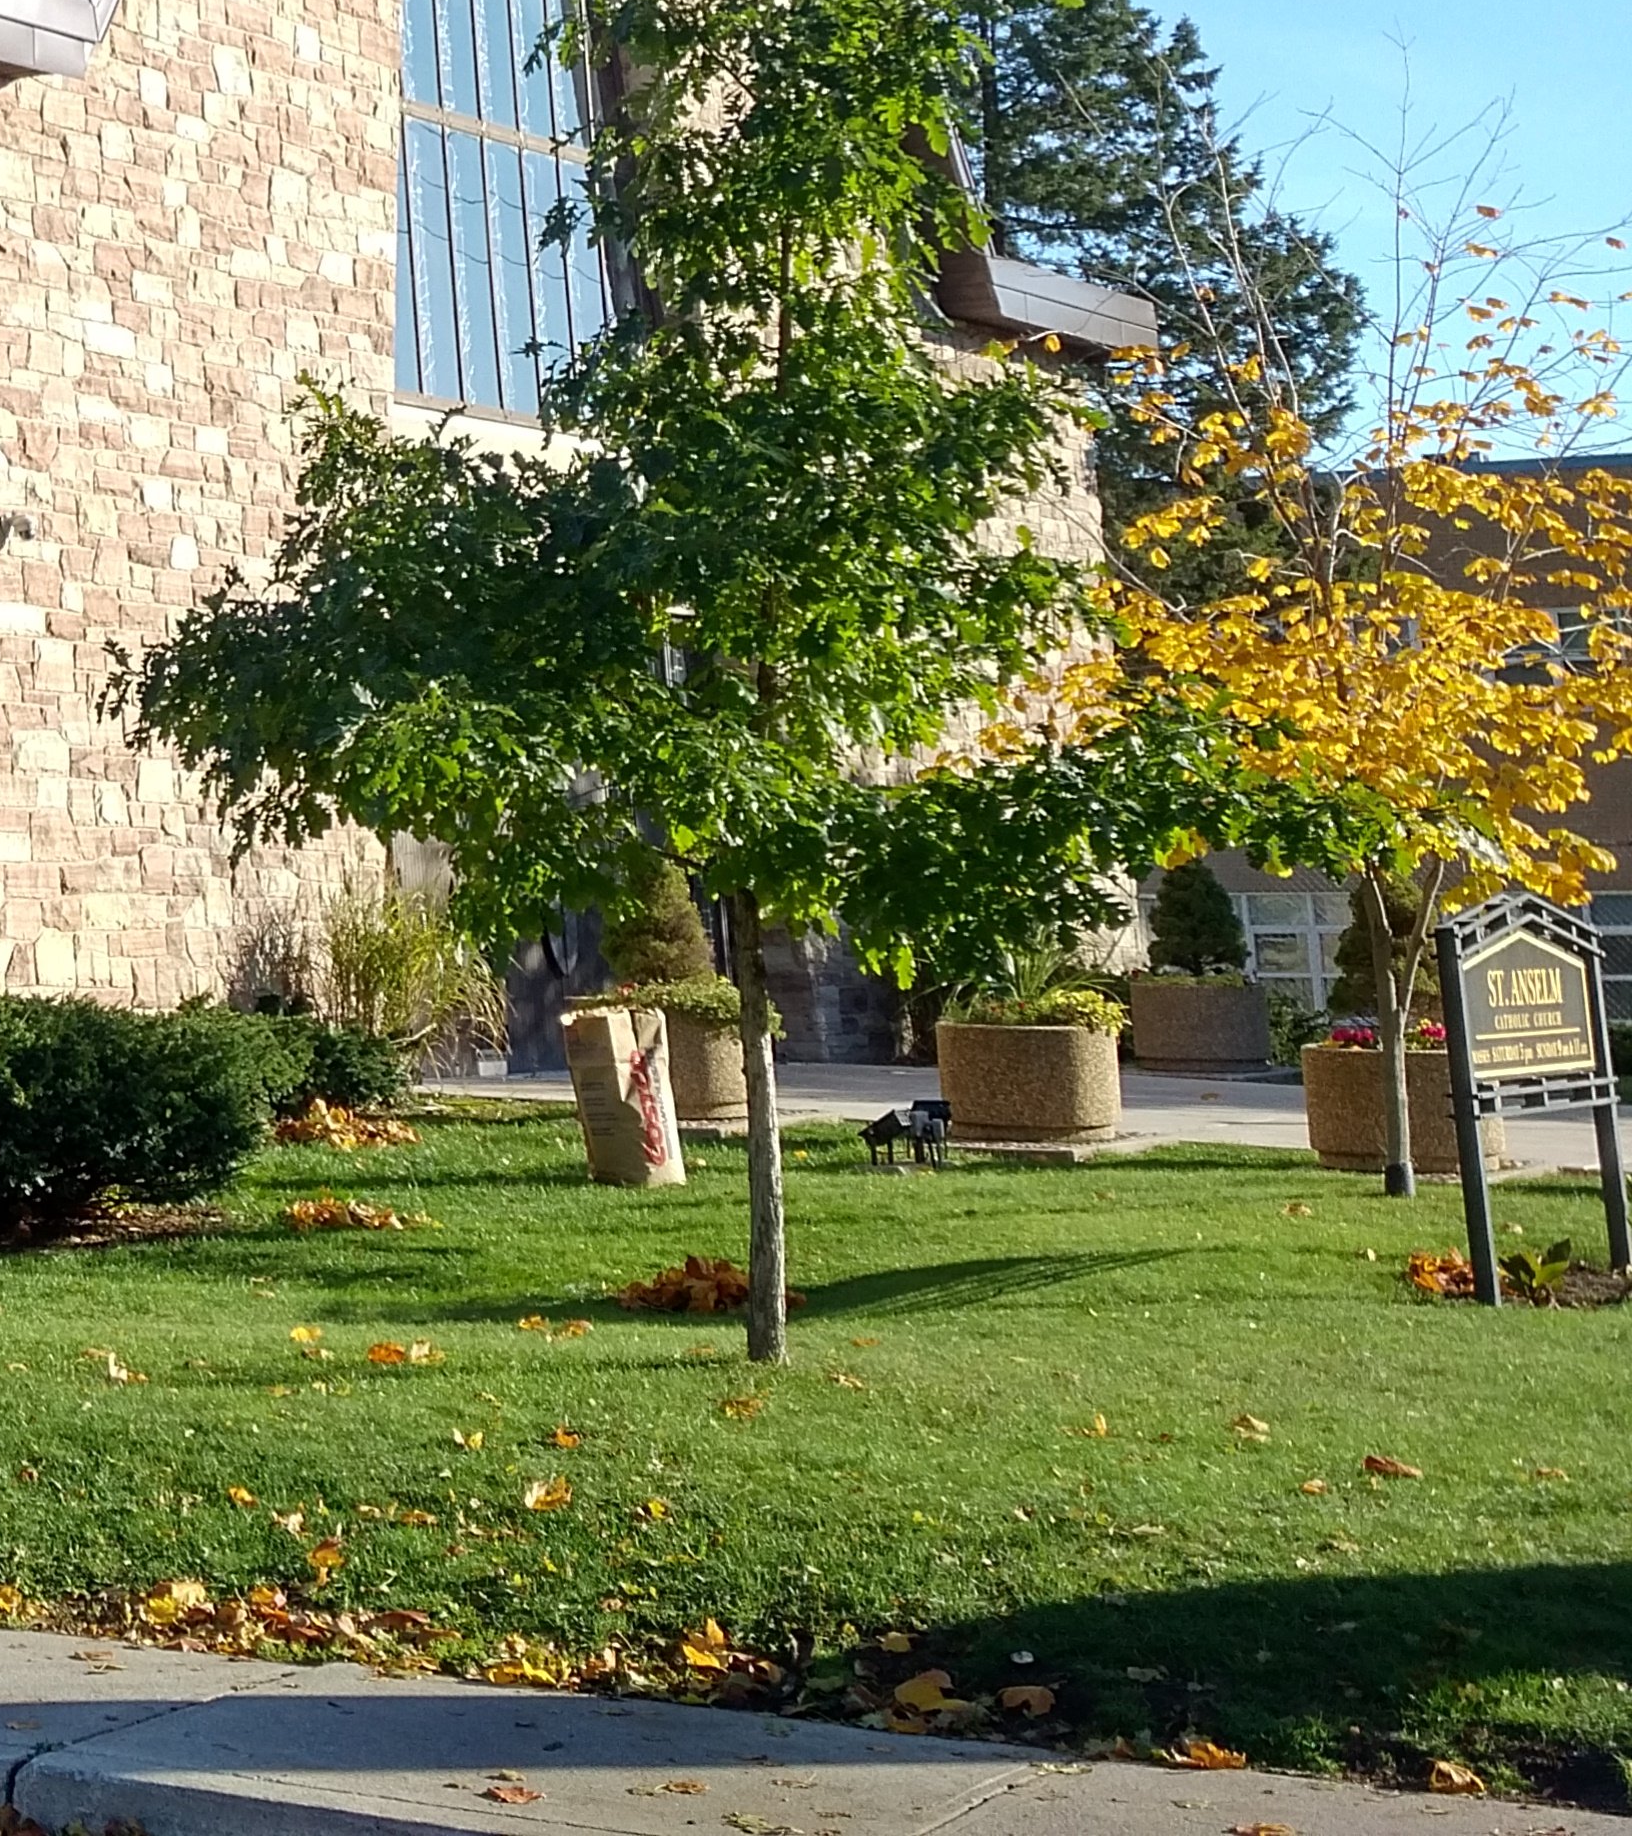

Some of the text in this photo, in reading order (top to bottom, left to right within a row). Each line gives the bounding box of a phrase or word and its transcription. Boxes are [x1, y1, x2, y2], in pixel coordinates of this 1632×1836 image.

[1511, 968, 1563, 1005] ANSELM
[1495, 1011, 1562, 1030] CATHOLIC CHURCH
